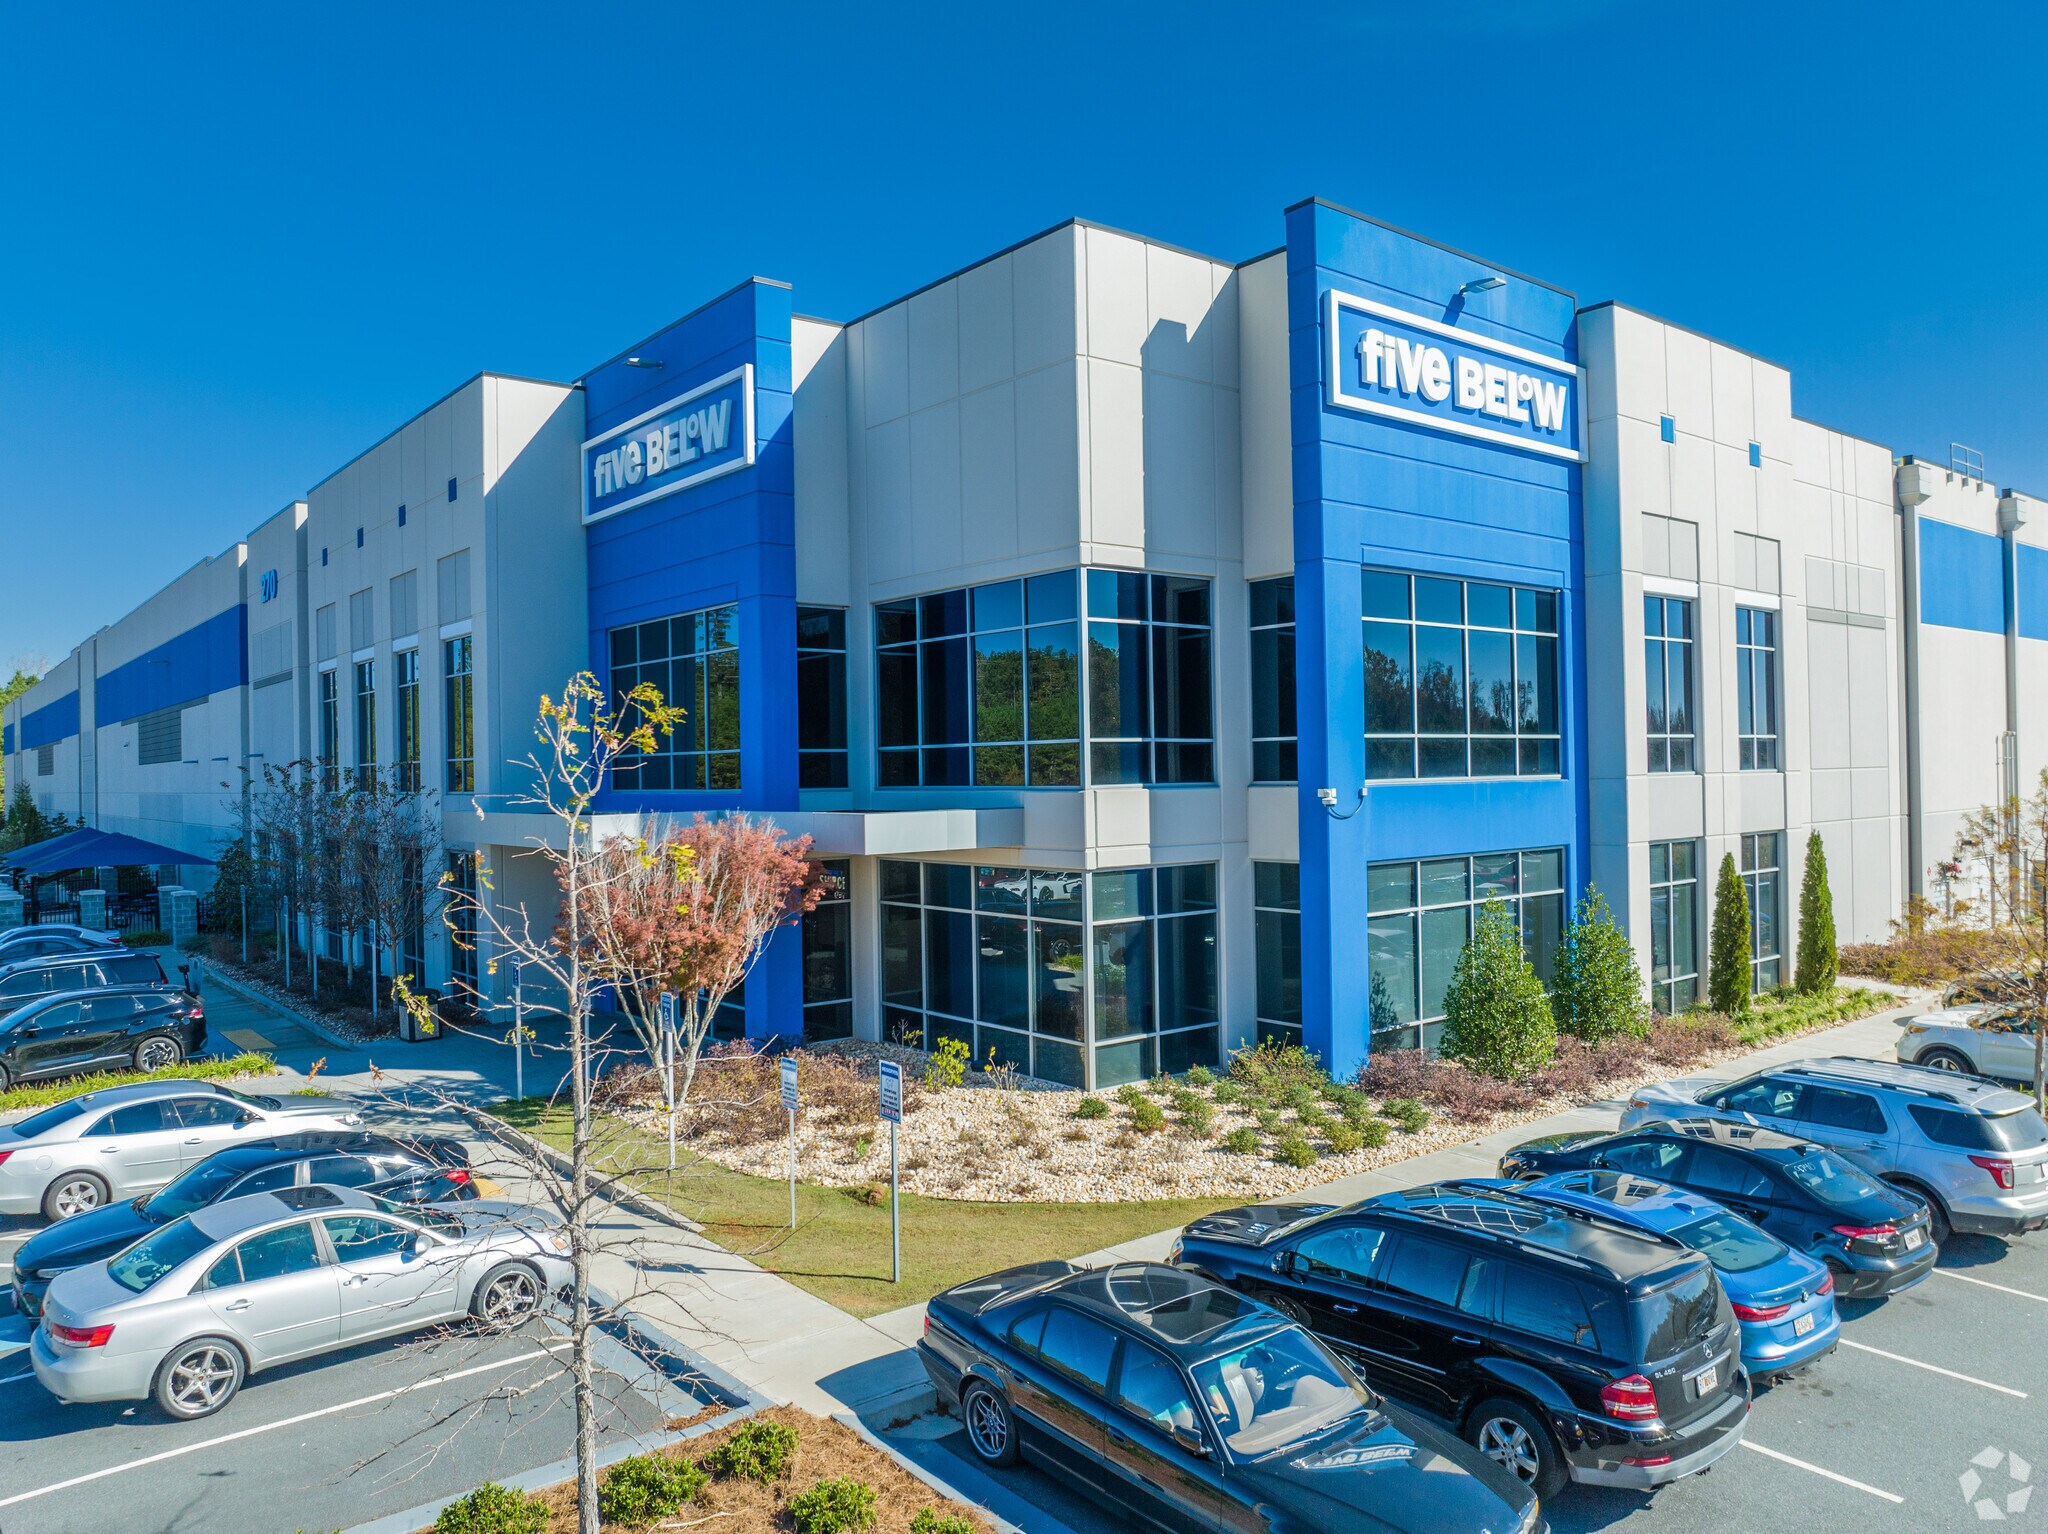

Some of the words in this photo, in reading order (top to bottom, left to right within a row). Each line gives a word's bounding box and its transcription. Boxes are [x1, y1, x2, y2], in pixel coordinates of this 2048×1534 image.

[1357, 328, 1451, 402] five
[594, 440, 645, 498] five
[260, 569, 278, 603] 270
